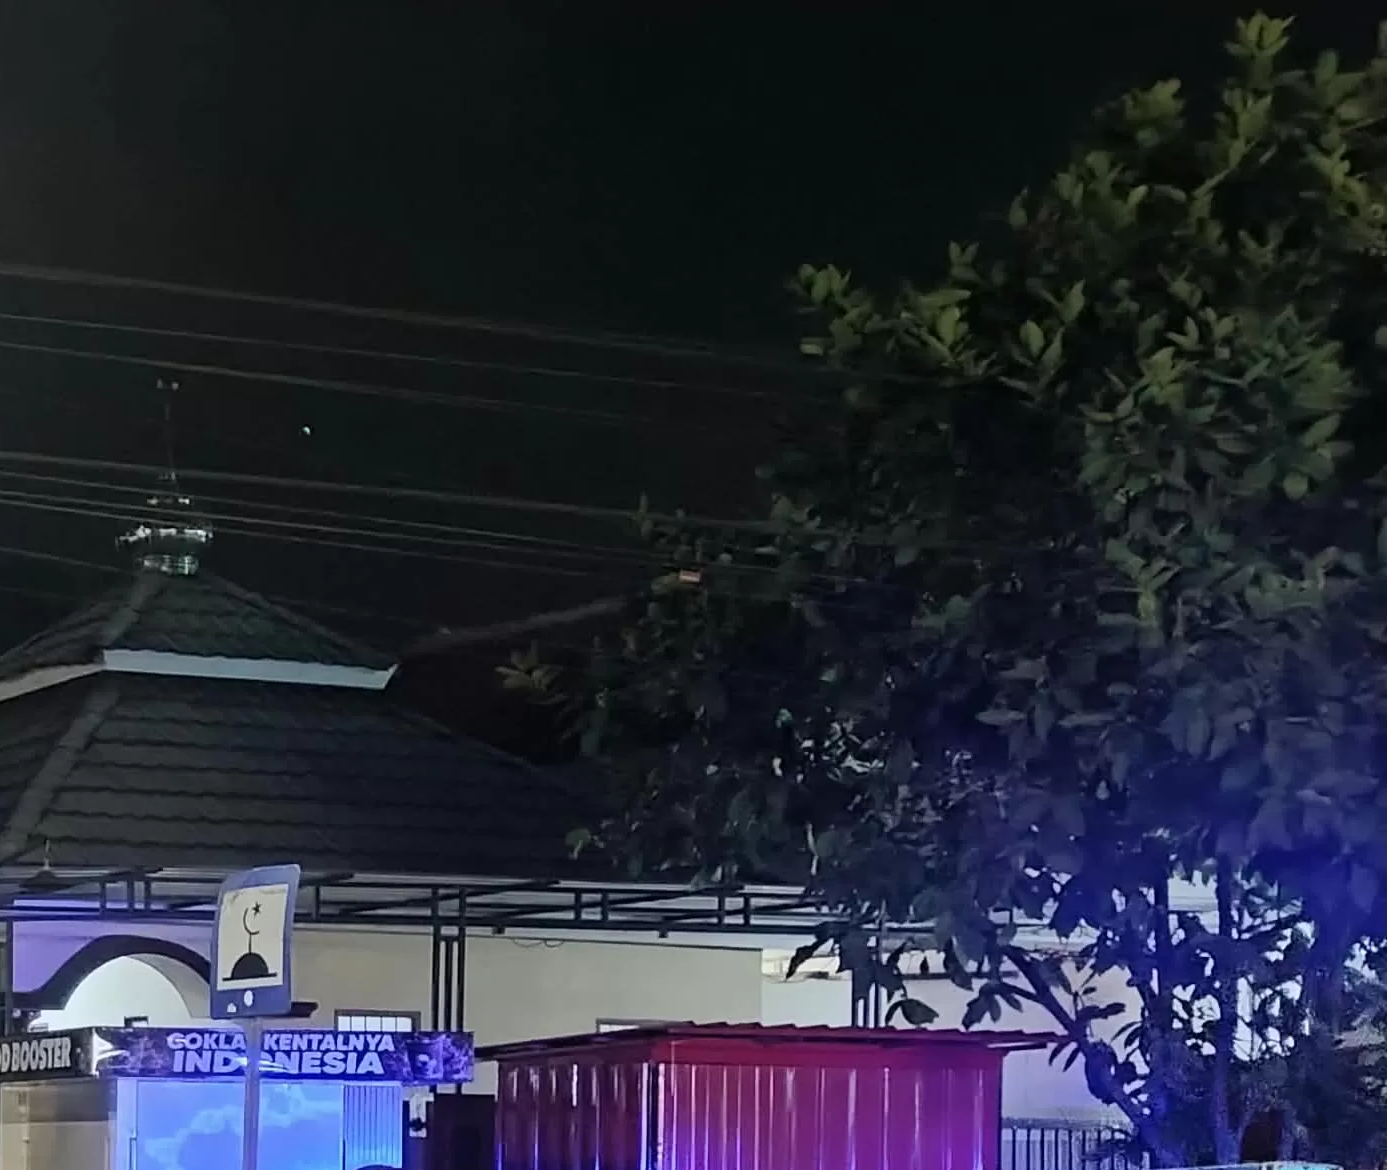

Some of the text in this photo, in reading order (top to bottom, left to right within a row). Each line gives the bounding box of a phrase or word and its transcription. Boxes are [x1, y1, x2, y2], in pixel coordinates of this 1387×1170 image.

[11, 1037, 71, 1071] BOOSTER
[263, 1033, 395, 1051] KENTALNYA
[173, 1050, 385, 1074] INDNESIA
